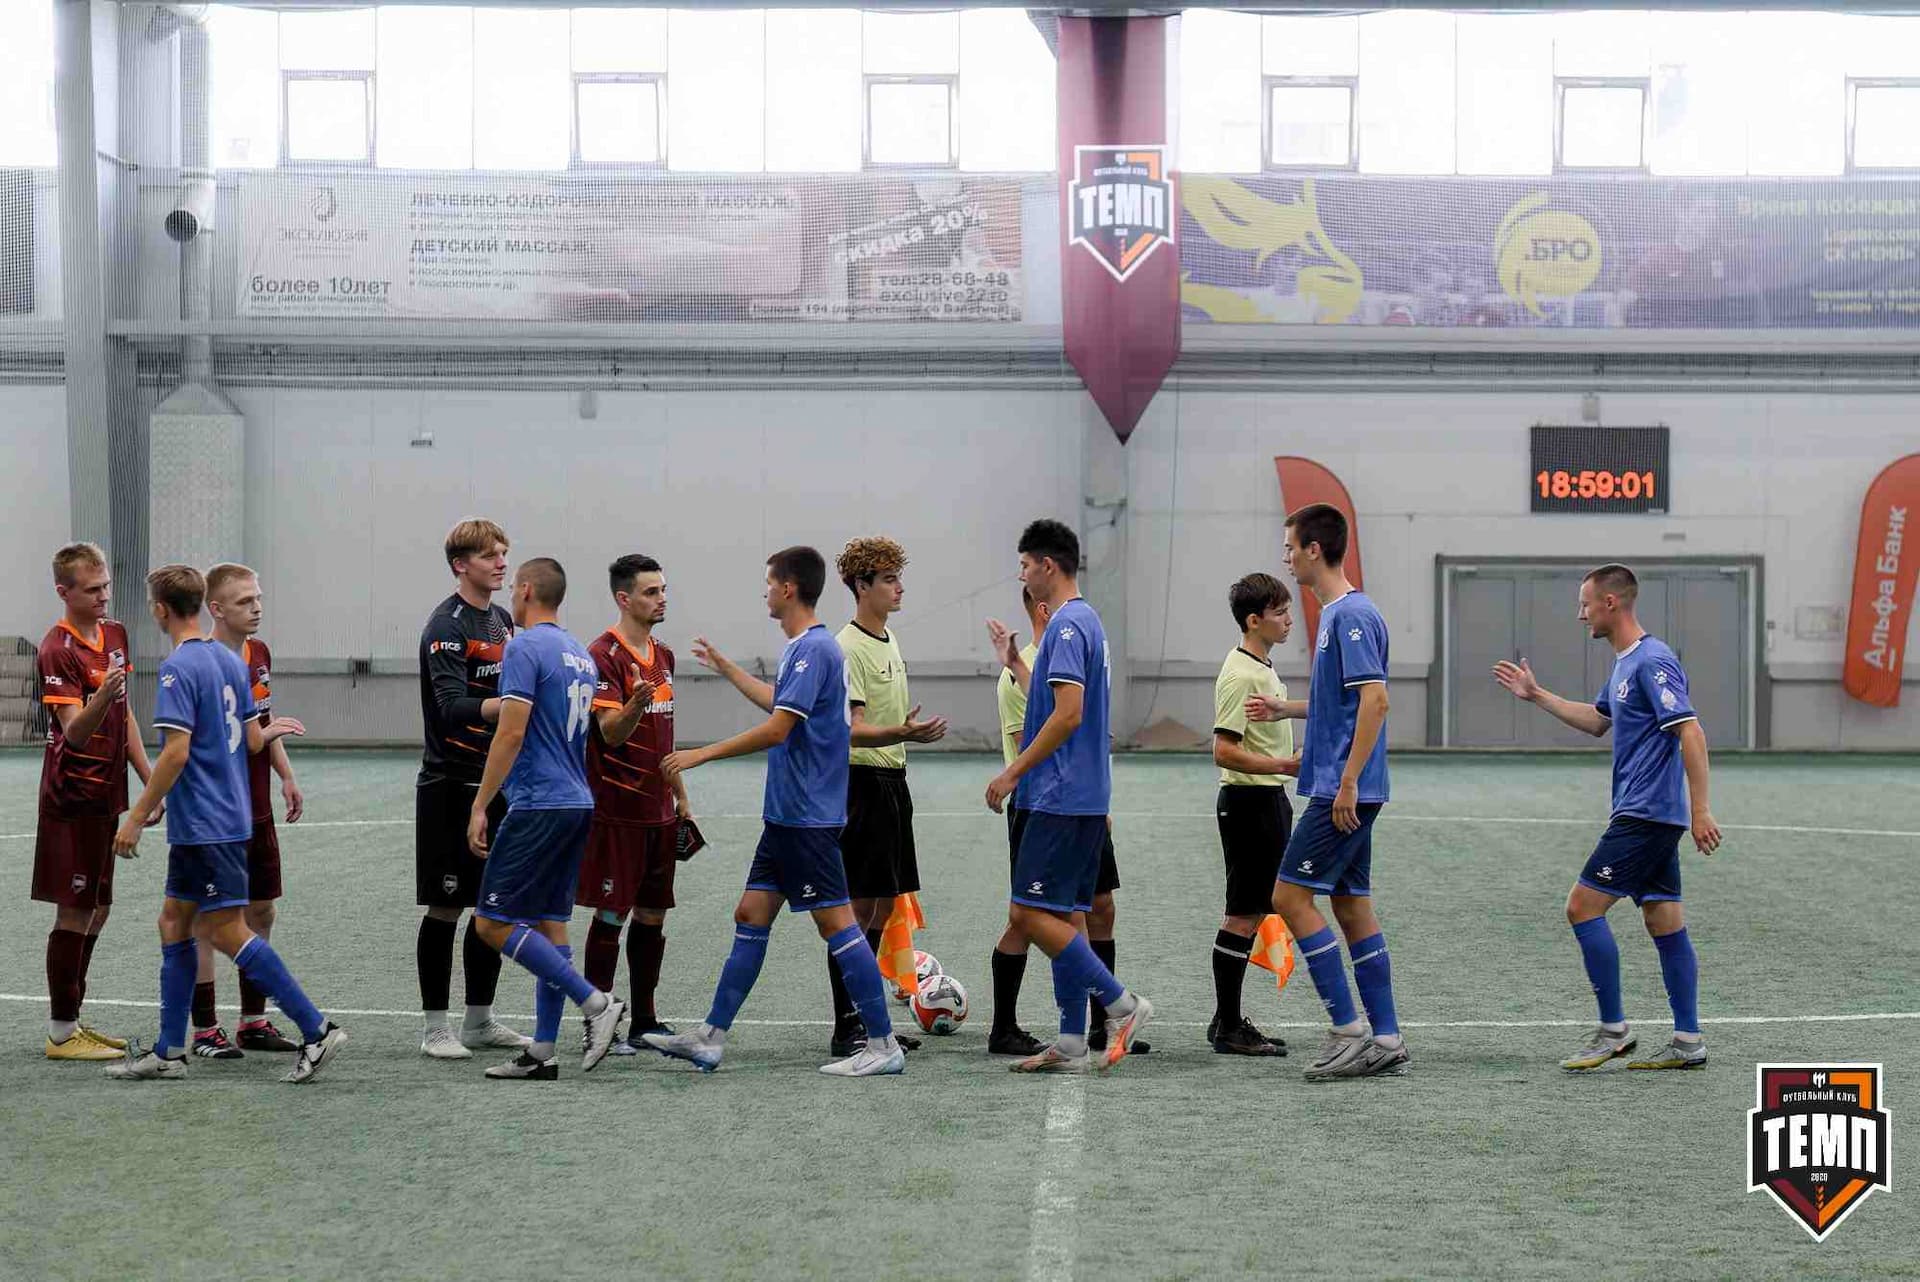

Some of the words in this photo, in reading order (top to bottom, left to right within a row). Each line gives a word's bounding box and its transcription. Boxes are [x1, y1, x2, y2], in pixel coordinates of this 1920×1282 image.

[1079, 183, 1163, 229] ТЕМП
[411, 236, 499, 255] ДЕТСКИЙ
[251, 275, 320, 294] более
[329, 276, 392, 294] 10лет
[1536, 470, 1654, 498] 18:59:01
[1875, 505, 1907, 574] Банк
[1863, 579, 1897, 669] Альфа
[222, 685, 243, 754] 3
